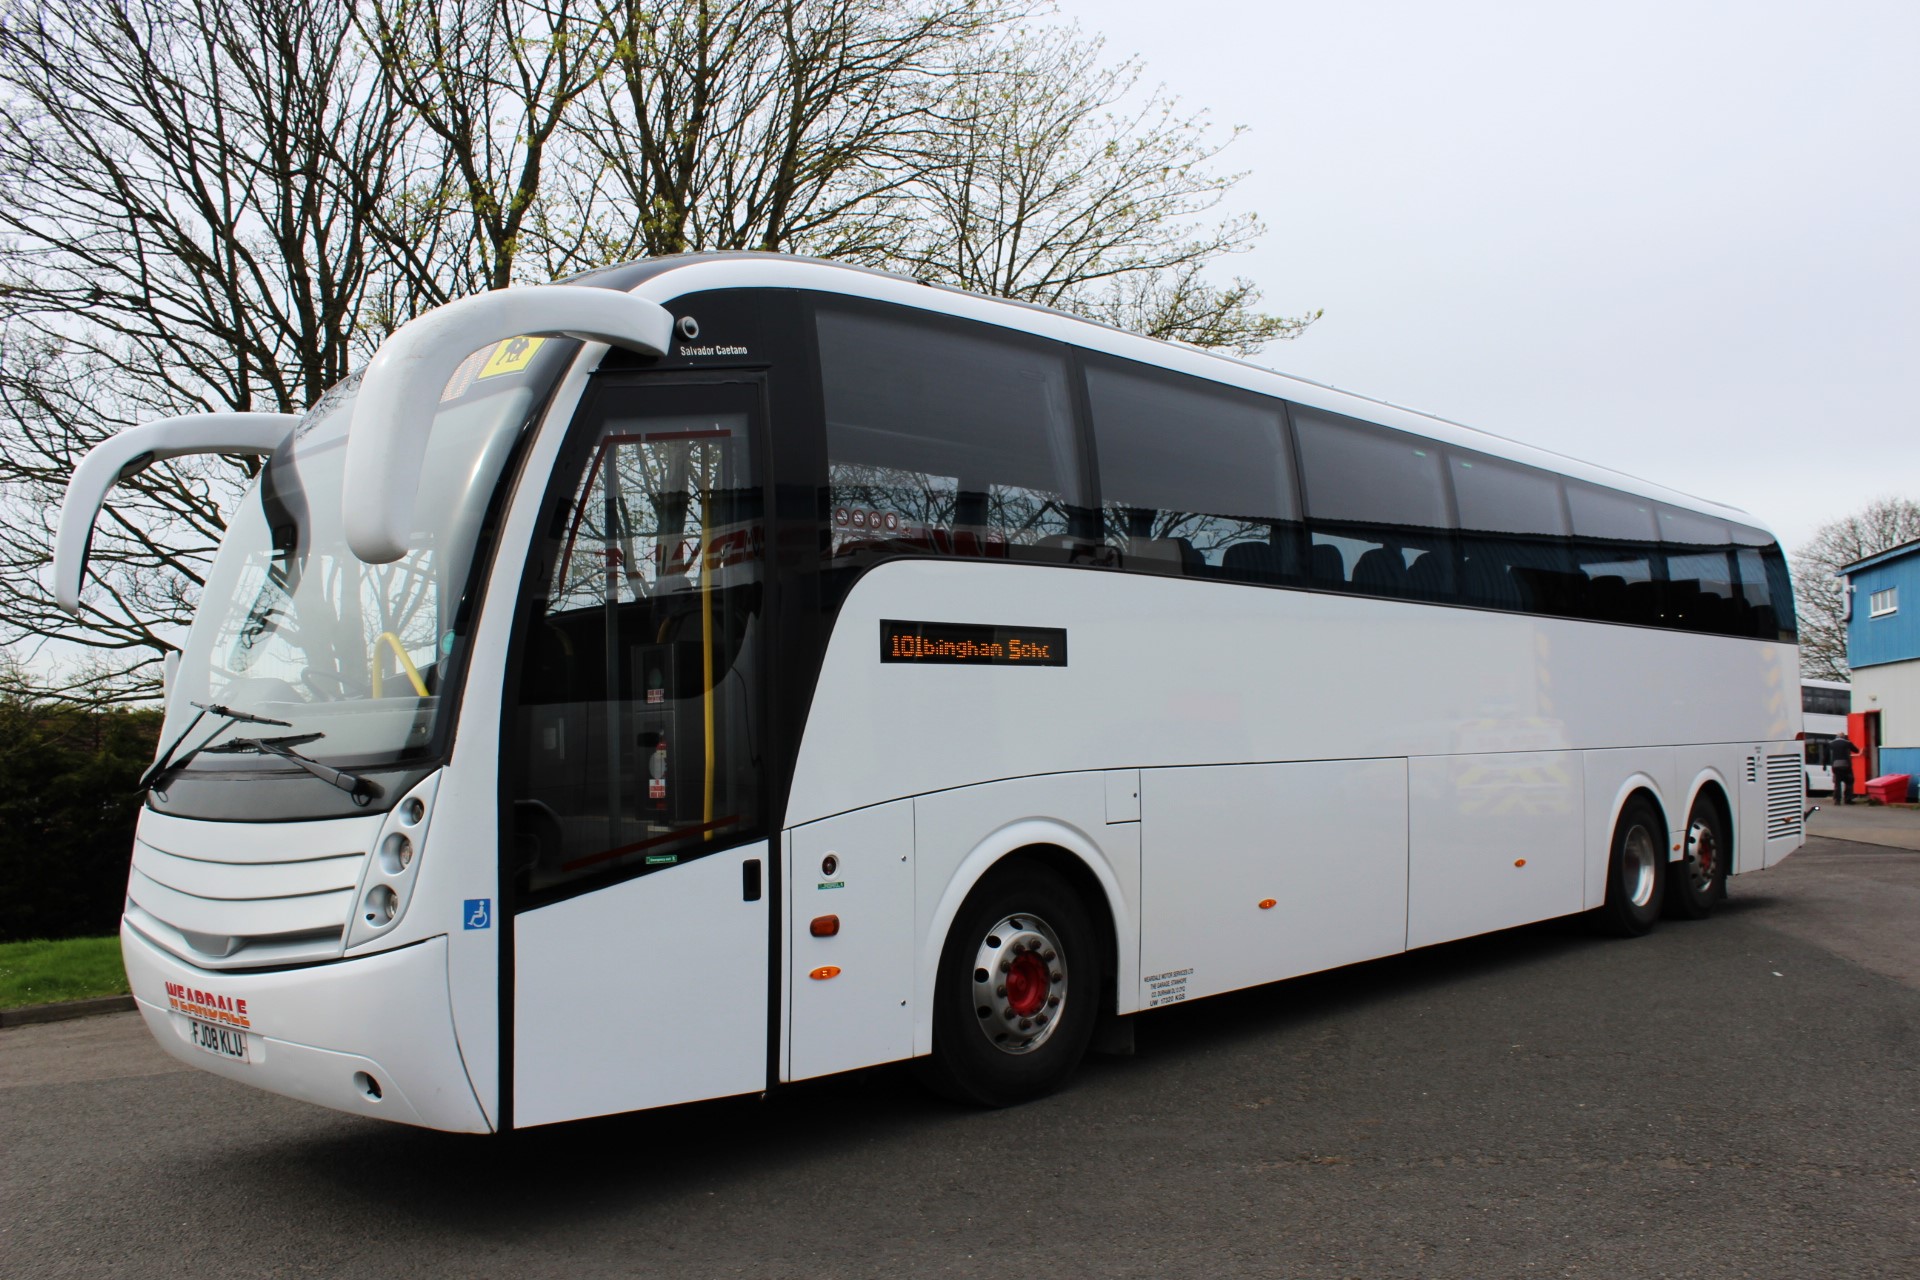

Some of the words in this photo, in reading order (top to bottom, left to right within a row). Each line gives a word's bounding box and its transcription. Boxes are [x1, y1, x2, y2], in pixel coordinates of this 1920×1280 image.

[680, 345, 714, 356] Salvador
[716, 345, 748, 355] Caetano
[165, 981, 251, 1030] WEARDALE
[219, 1029, 244, 1057] KLU
